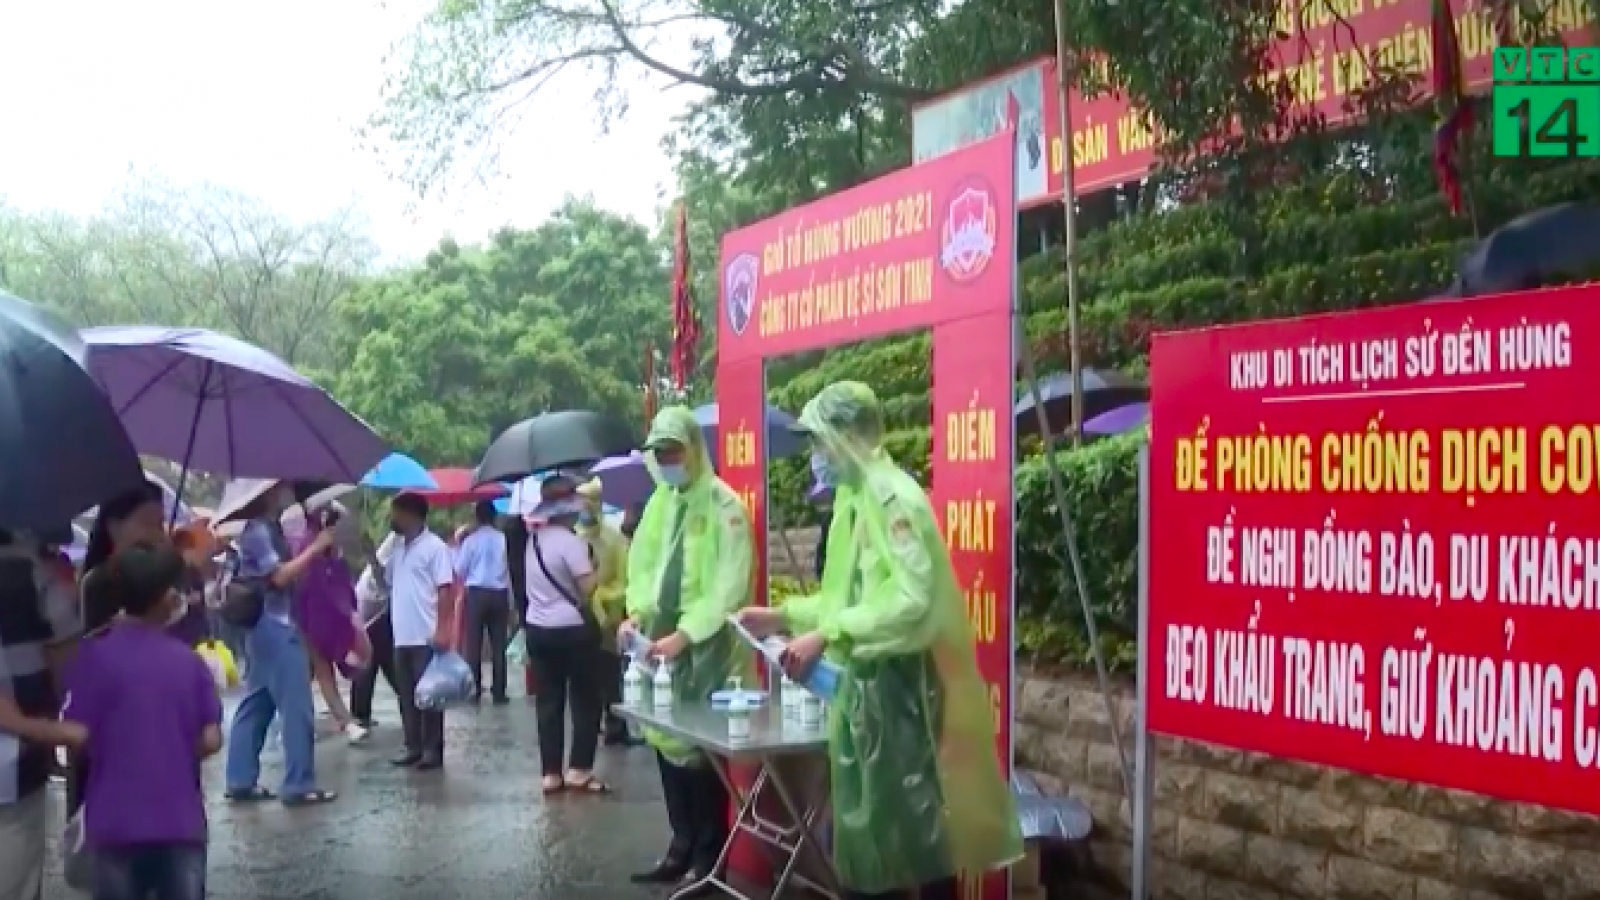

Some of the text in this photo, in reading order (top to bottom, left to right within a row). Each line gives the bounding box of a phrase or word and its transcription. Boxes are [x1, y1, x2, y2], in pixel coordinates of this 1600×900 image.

[843, 202, 892, 253] VƯƠNG
[894, 189, 932, 239] 2021
[1230, 350, 1269, 390] KHU
[1273, 347, 1294, 387] DI
[1299, 339, 1344, 384] TÍCH
[1349, 338, 1399, 390] LỊCH
[1405, 318, 1438, 378] SỬ
[1499, 317, 1571, 370] HÙNG
[1216, 421, 1313, 493] PHÒNG
[1320, 410, 1431, 494] CHỐNG
[1441, 427, 1528, 507] DỊCH
[947, 487, 996, 553] PHÁT
[1241, 528, 1297, 602] NGHỊ
[1303, 508, 1373, 593] ĐỒNG
[1380, 518, 1443, 607] BÀO,
[1449, 534, 1490, 602] DU
[1166, 600, 1600, 769] ĐEO KHẨU TRANG, GIỮ KHOẢNG C
